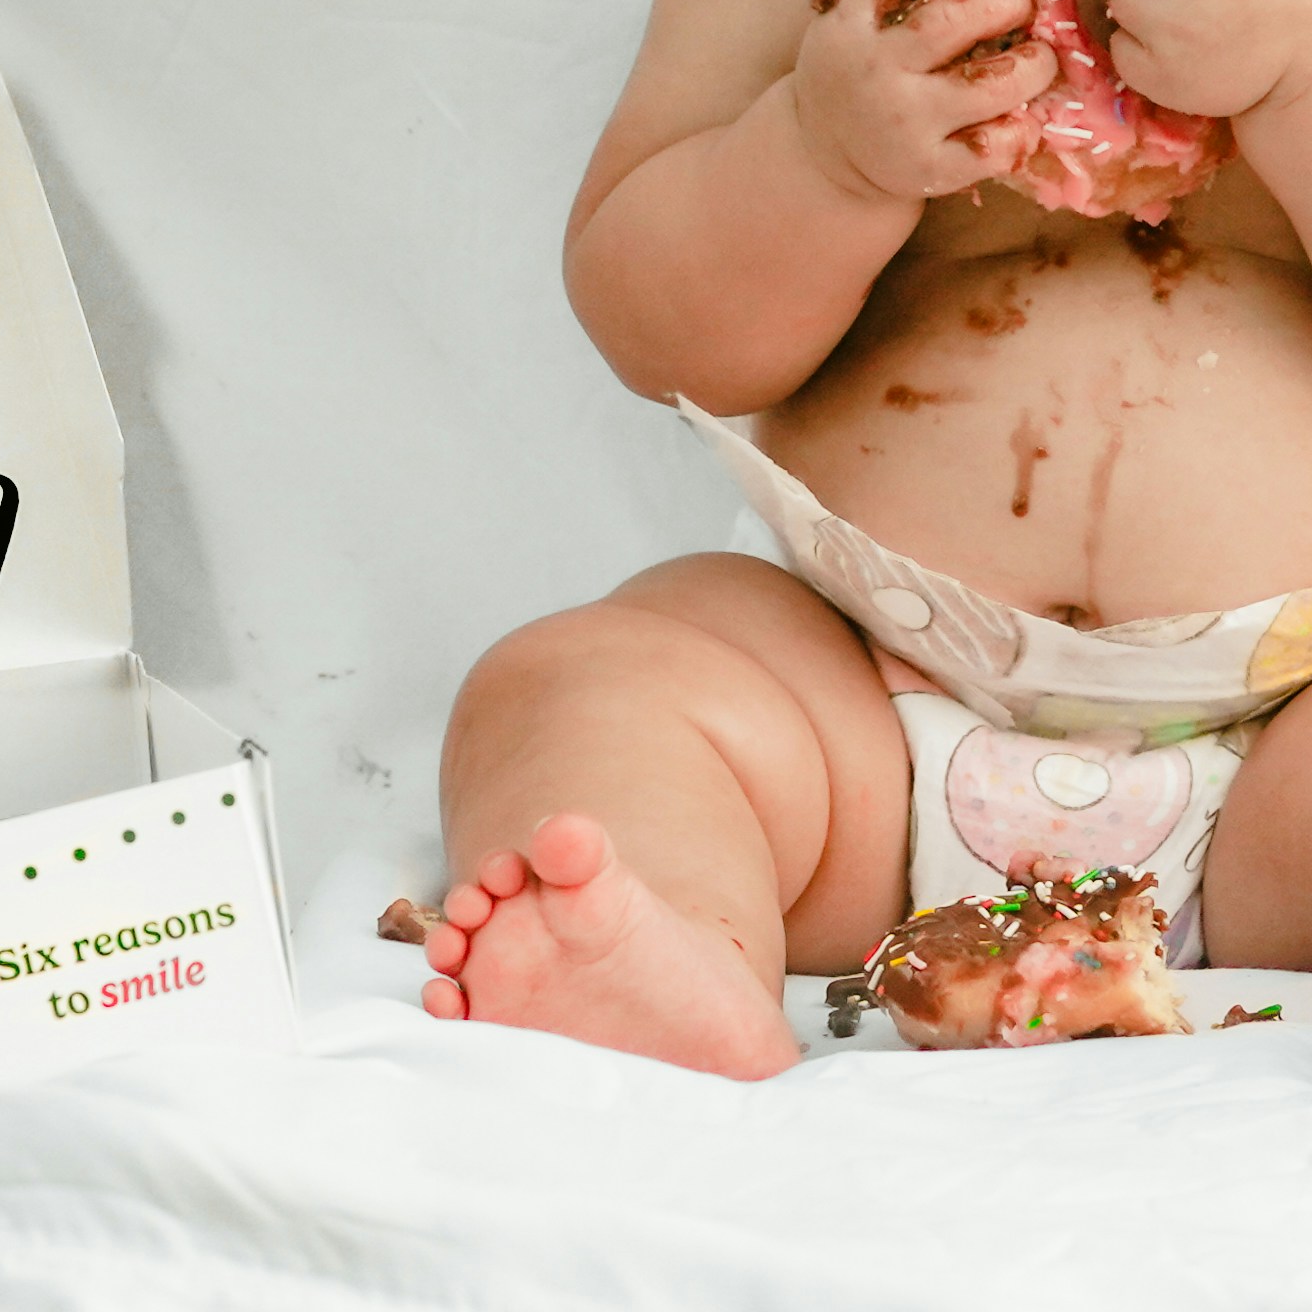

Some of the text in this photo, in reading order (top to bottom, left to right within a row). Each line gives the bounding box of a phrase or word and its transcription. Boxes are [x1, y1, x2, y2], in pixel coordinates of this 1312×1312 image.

[72, 902, 236, 963] reasons
[48, 955, 206, 1019] to smile
